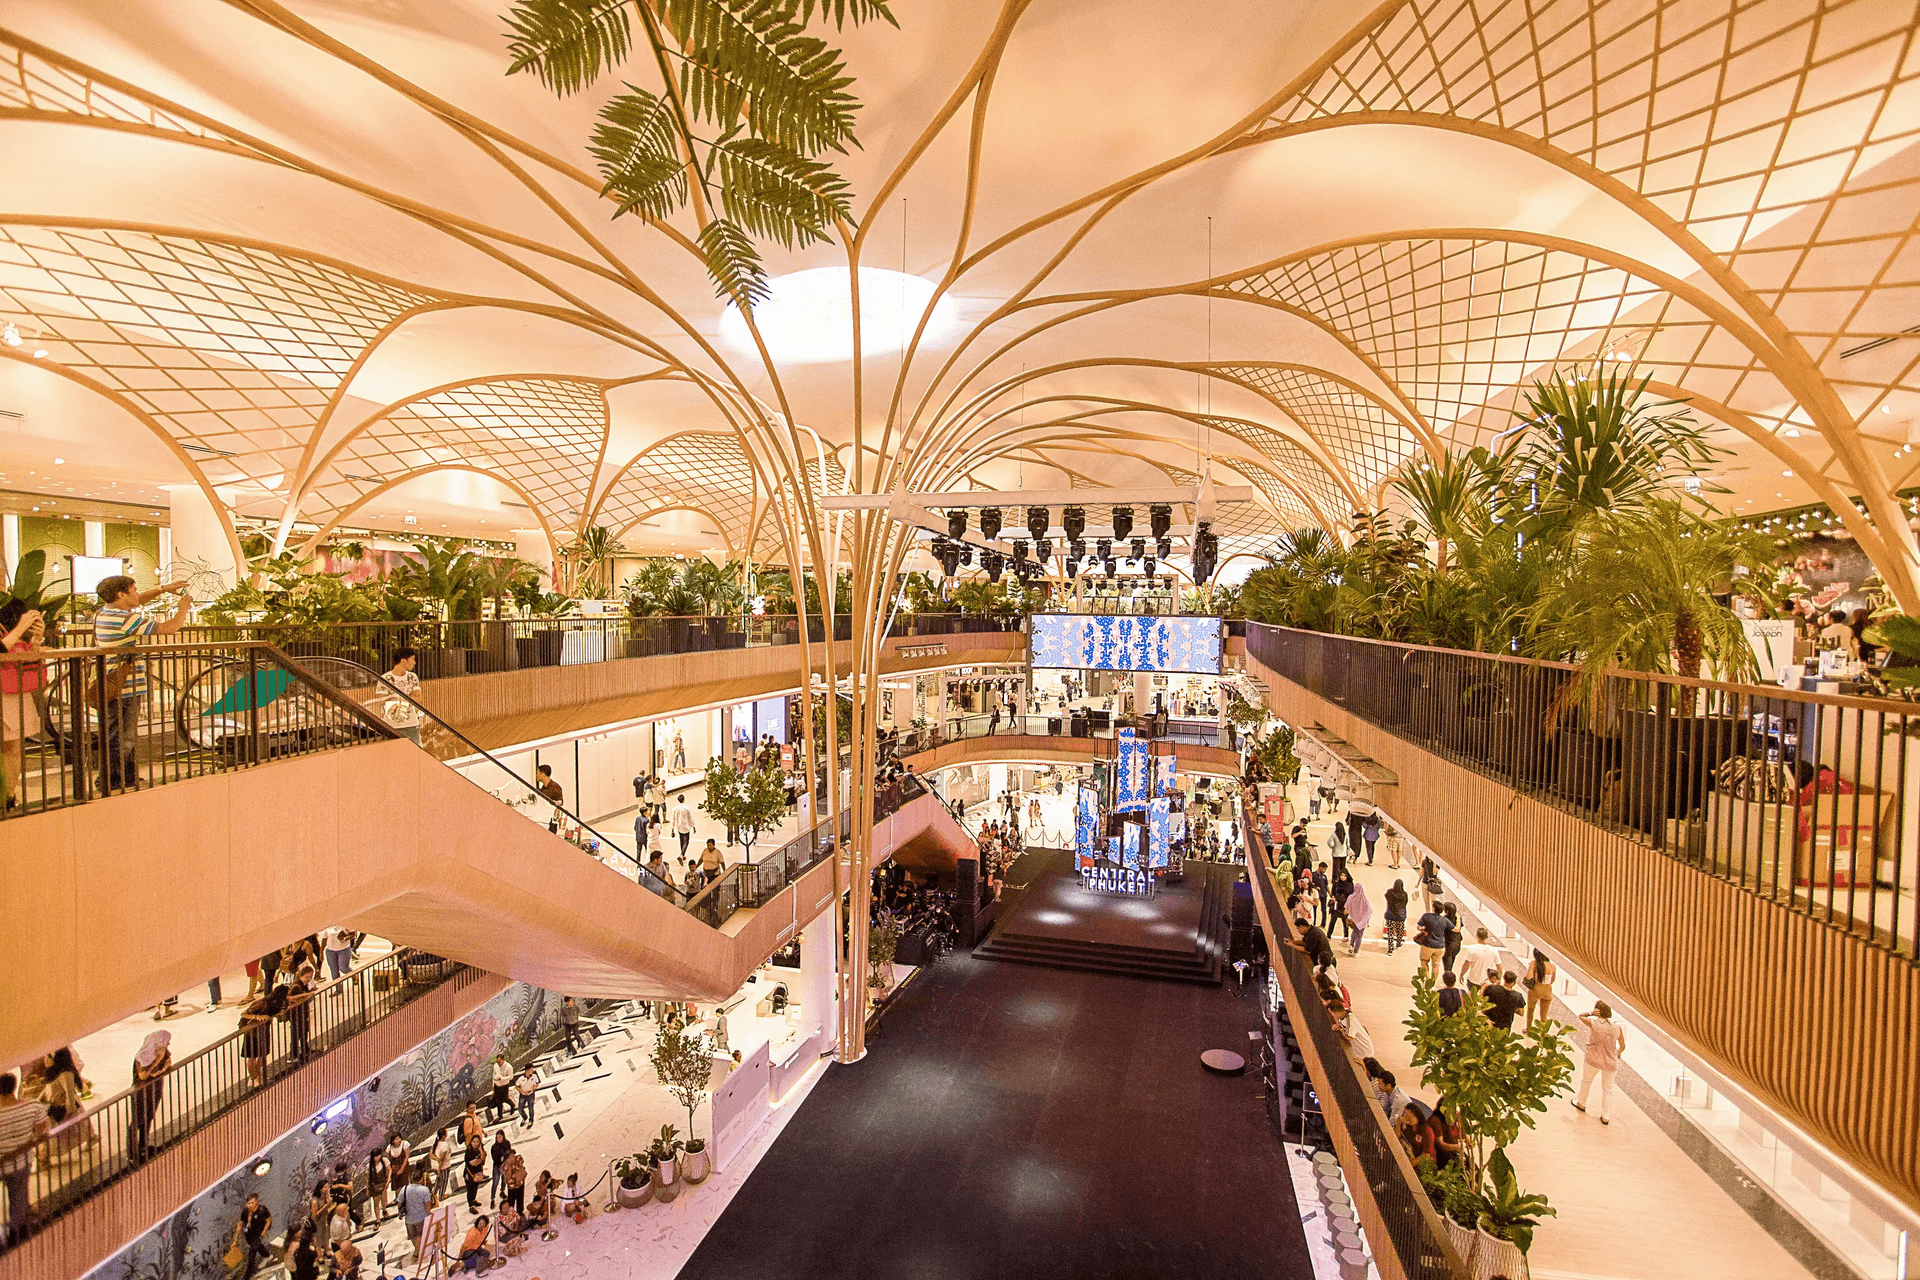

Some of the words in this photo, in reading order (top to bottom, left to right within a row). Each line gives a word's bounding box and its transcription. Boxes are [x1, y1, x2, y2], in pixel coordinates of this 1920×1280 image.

[1088, 634, 1164, 645] CENTRAL
[1098, 646, 1155, 657] PHUKET
[1081, 866, 1155, 882] CENTRAL
[1089, 878, 1147, 894] PHUKET
